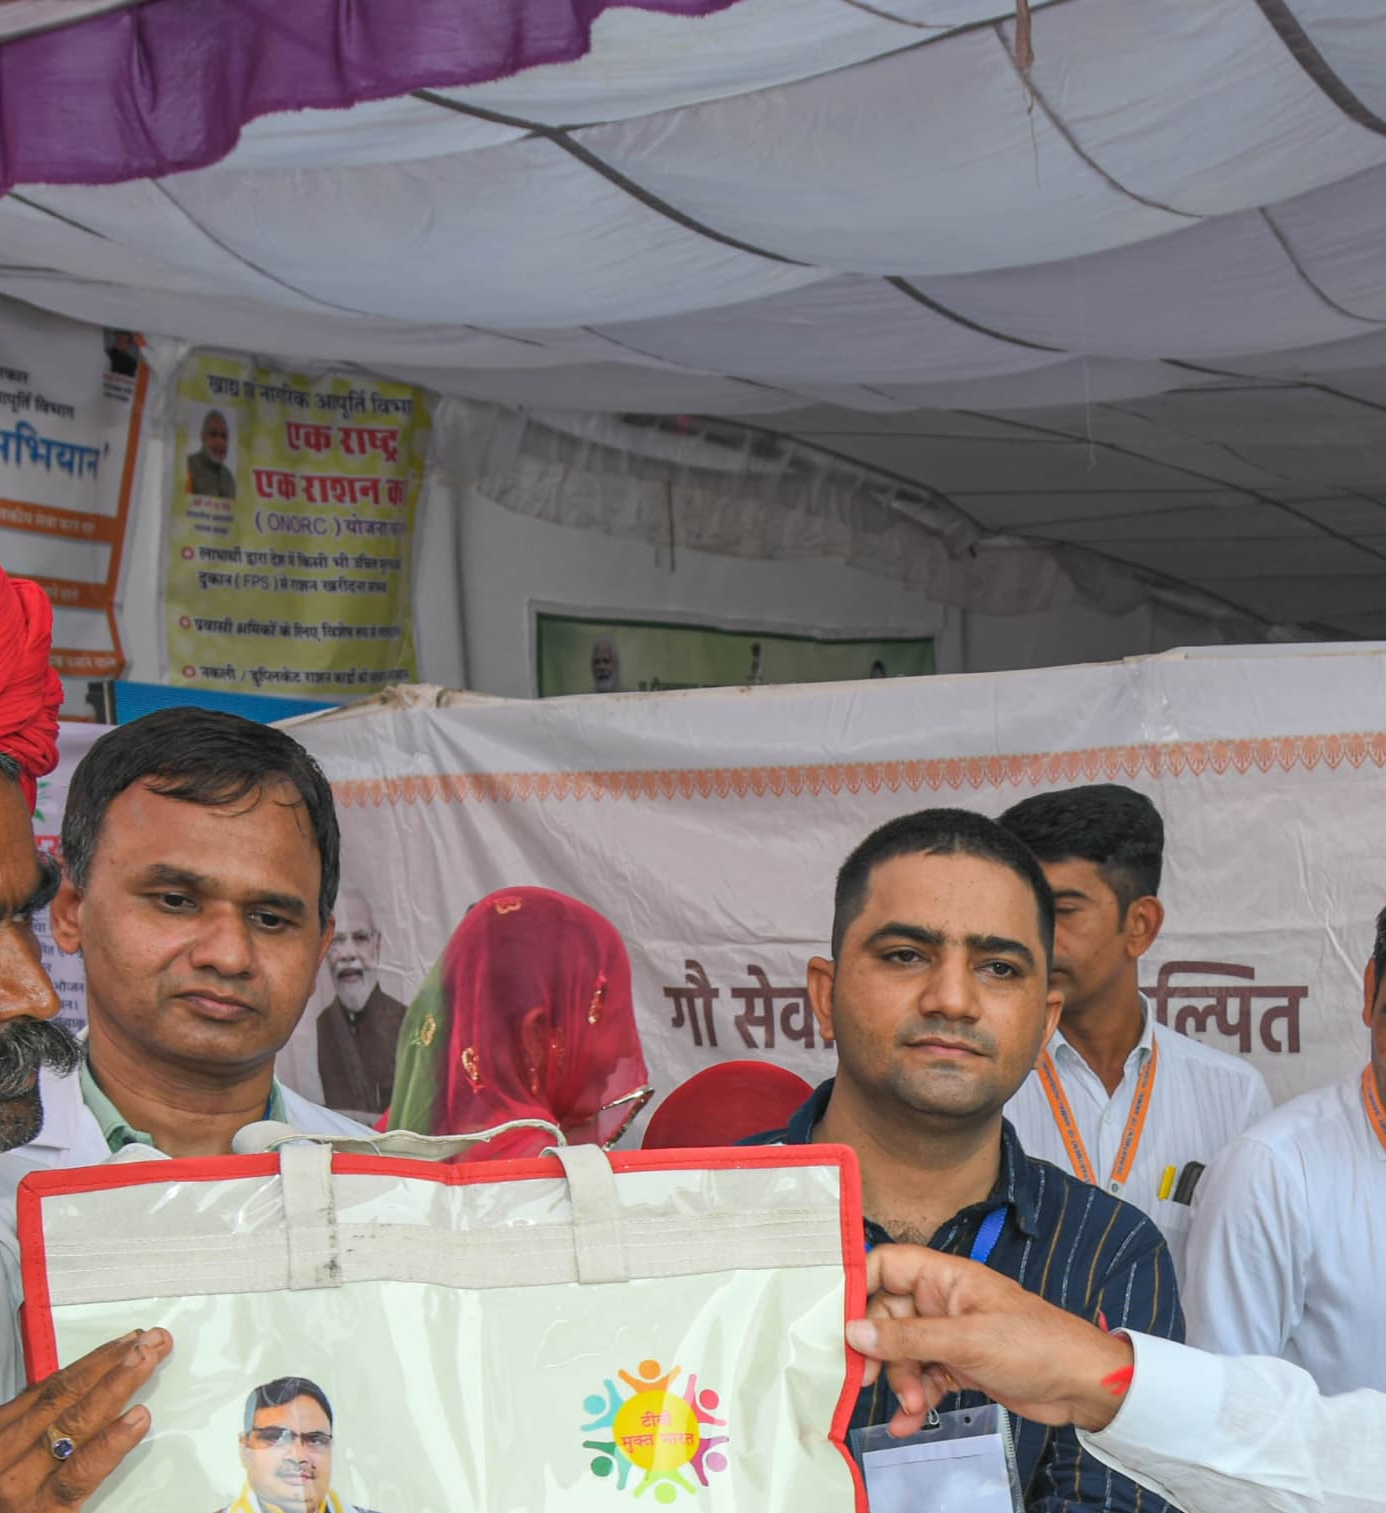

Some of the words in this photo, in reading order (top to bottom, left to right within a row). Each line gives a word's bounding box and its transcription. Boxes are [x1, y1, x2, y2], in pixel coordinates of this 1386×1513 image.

[35, 394, 75, 419] विभाग
[208, 375, 239, 398] खाद्य
[316, 390, 366, 420] आपूर्ति
[286, 421, 332, 452] एक
[339, 426, 400, 463] राष्ट्र
[253, 468, 297, 501] एक
[302, 474, 382, 507] राशन
[663, 959, 719, 1047] गौ
[731, 964, 834, 1048] सेव
[621, 1434, 654, 1453] मुक्त
